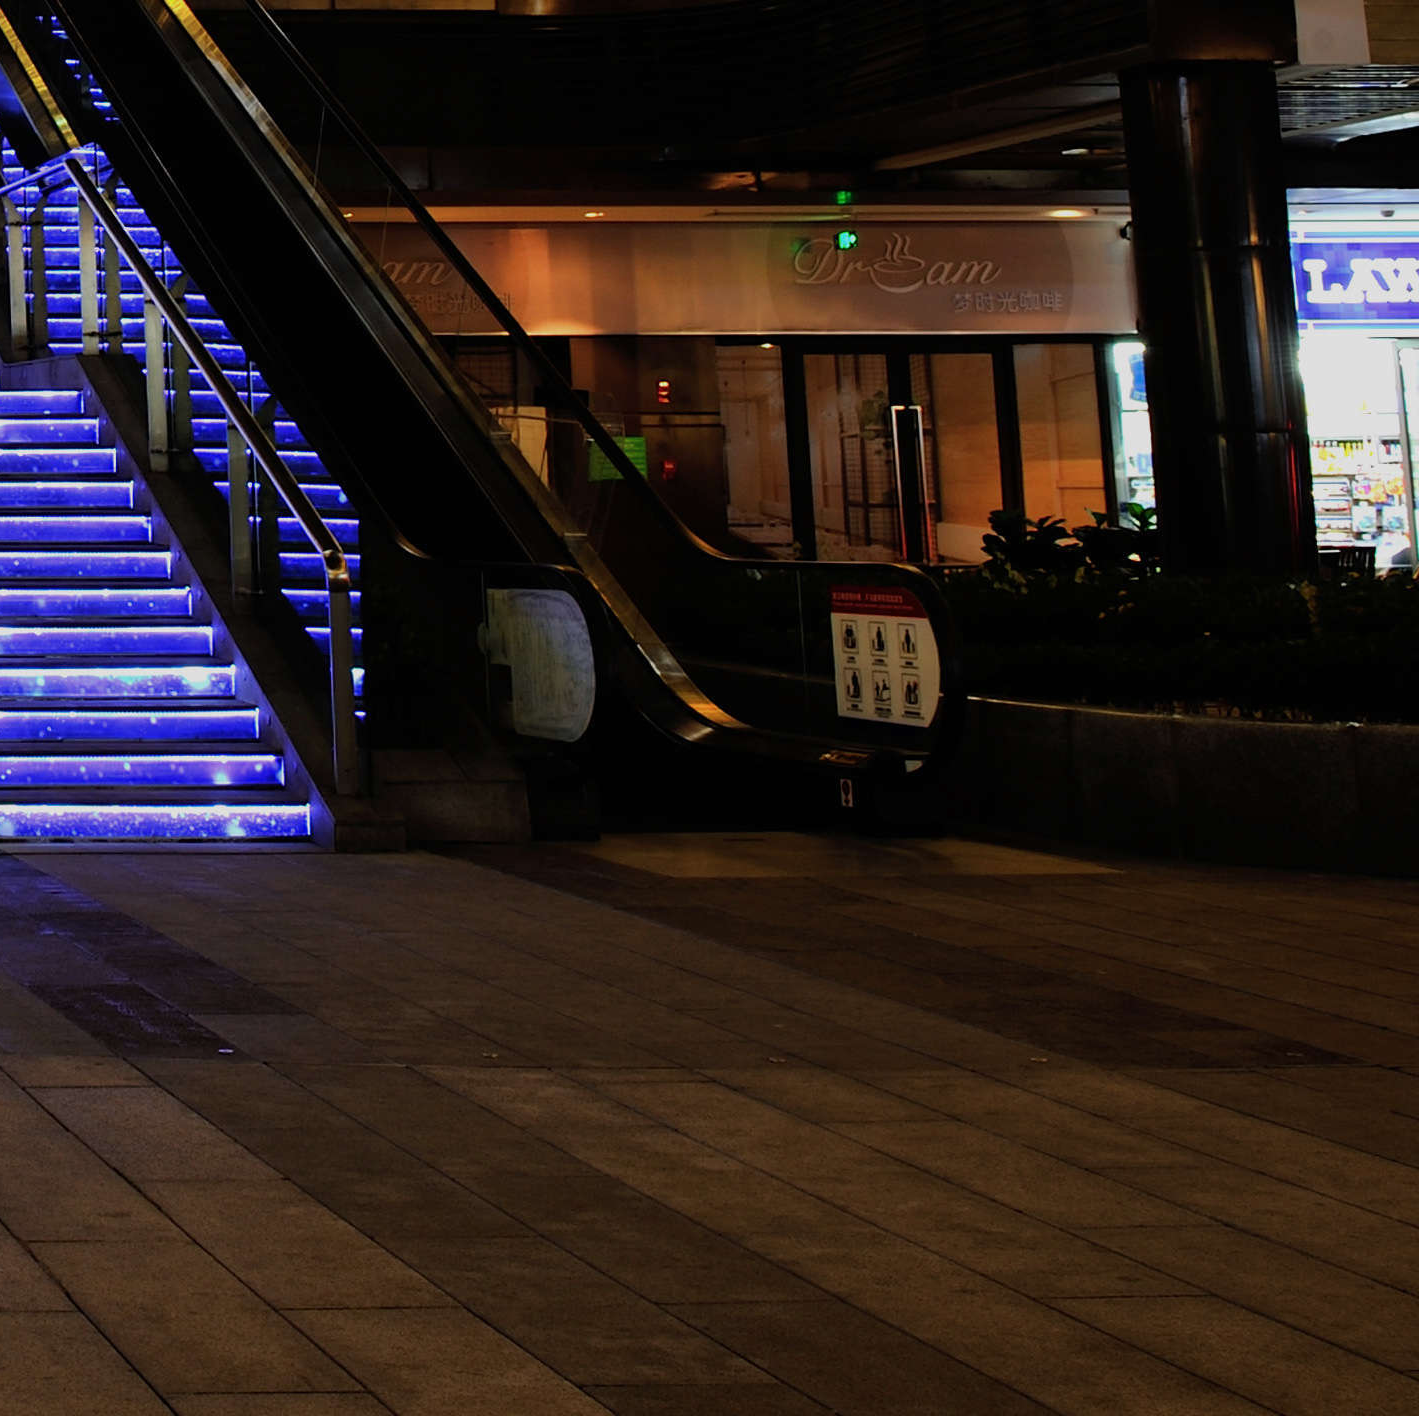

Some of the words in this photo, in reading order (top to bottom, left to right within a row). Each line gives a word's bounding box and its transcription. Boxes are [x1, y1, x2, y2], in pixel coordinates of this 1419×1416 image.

[953, 290, 1065, 314] 梦时光咖啡
